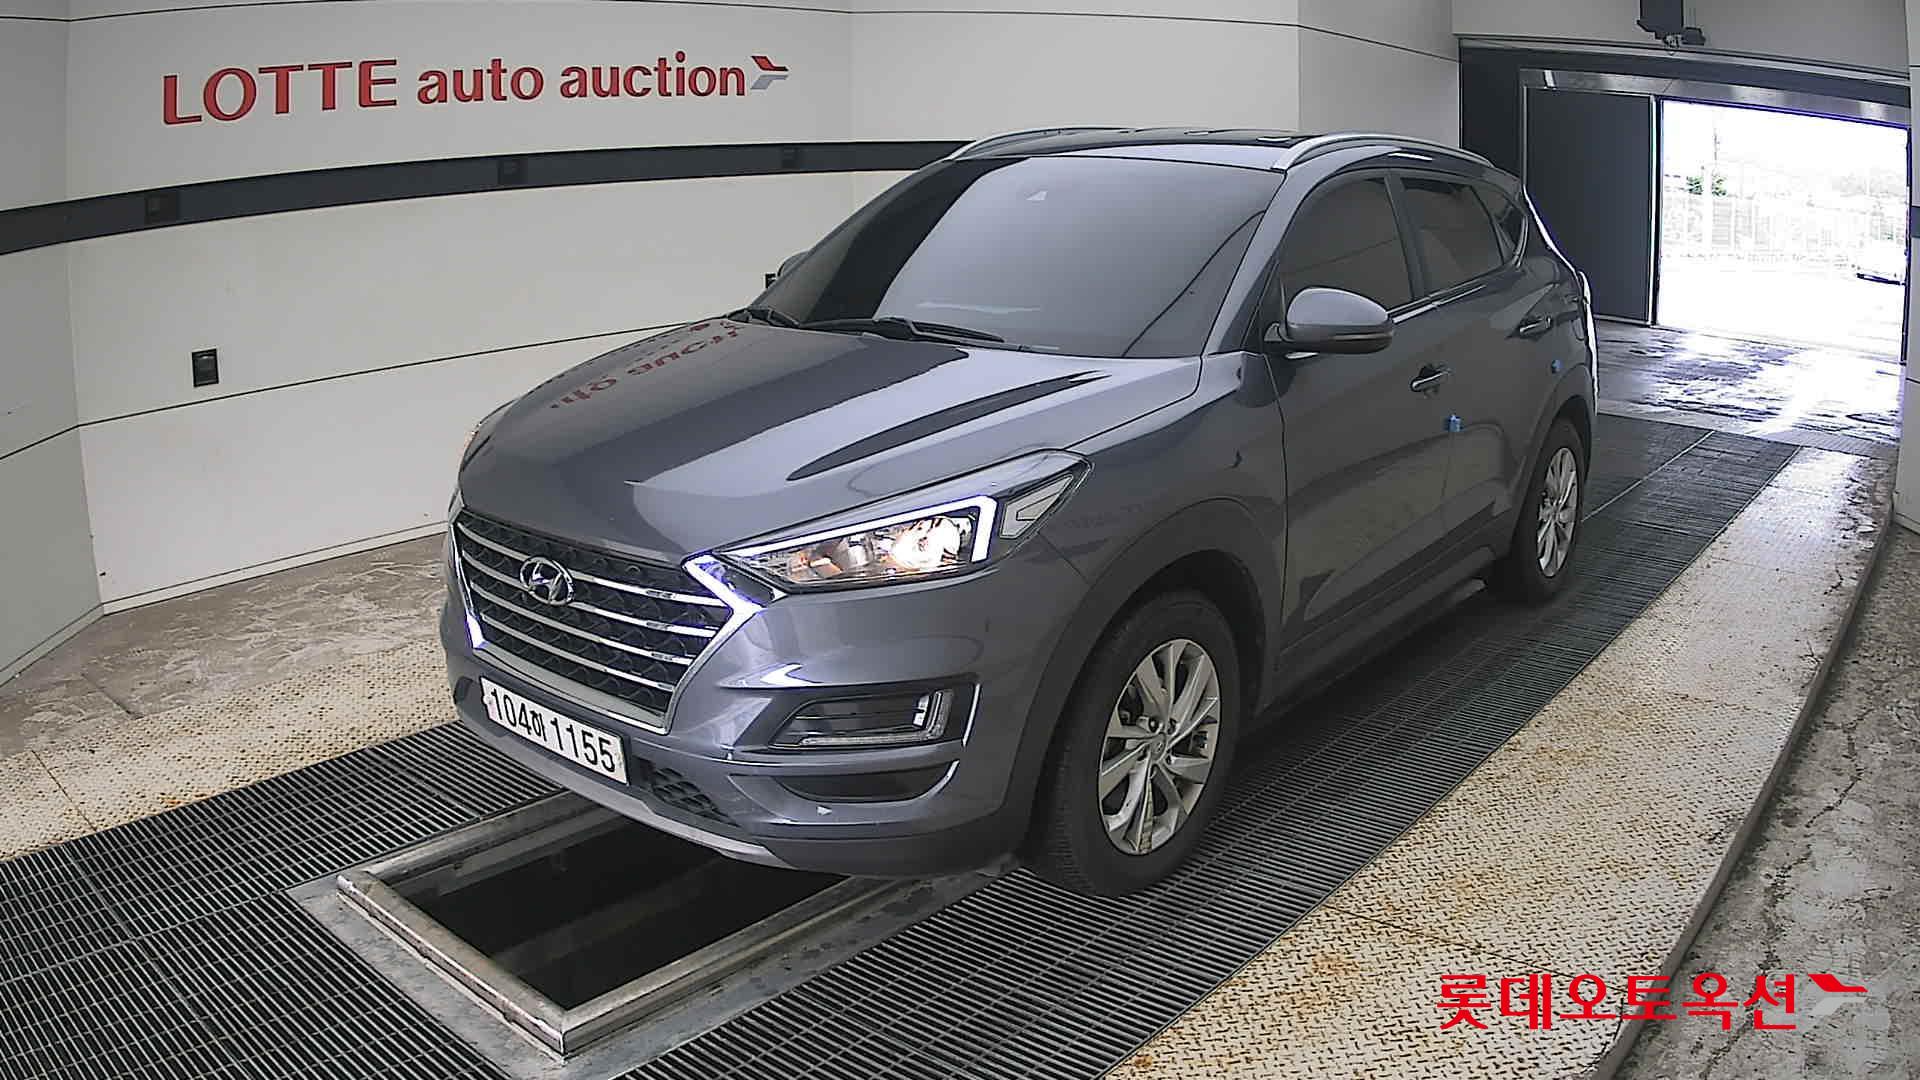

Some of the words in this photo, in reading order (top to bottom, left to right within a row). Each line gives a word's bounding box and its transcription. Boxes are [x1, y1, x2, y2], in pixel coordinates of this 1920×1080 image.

[163, 59, 397, 126] LOTTE
[416, 58, 545, 105] auto
[559, 50, 746, 98] auction
